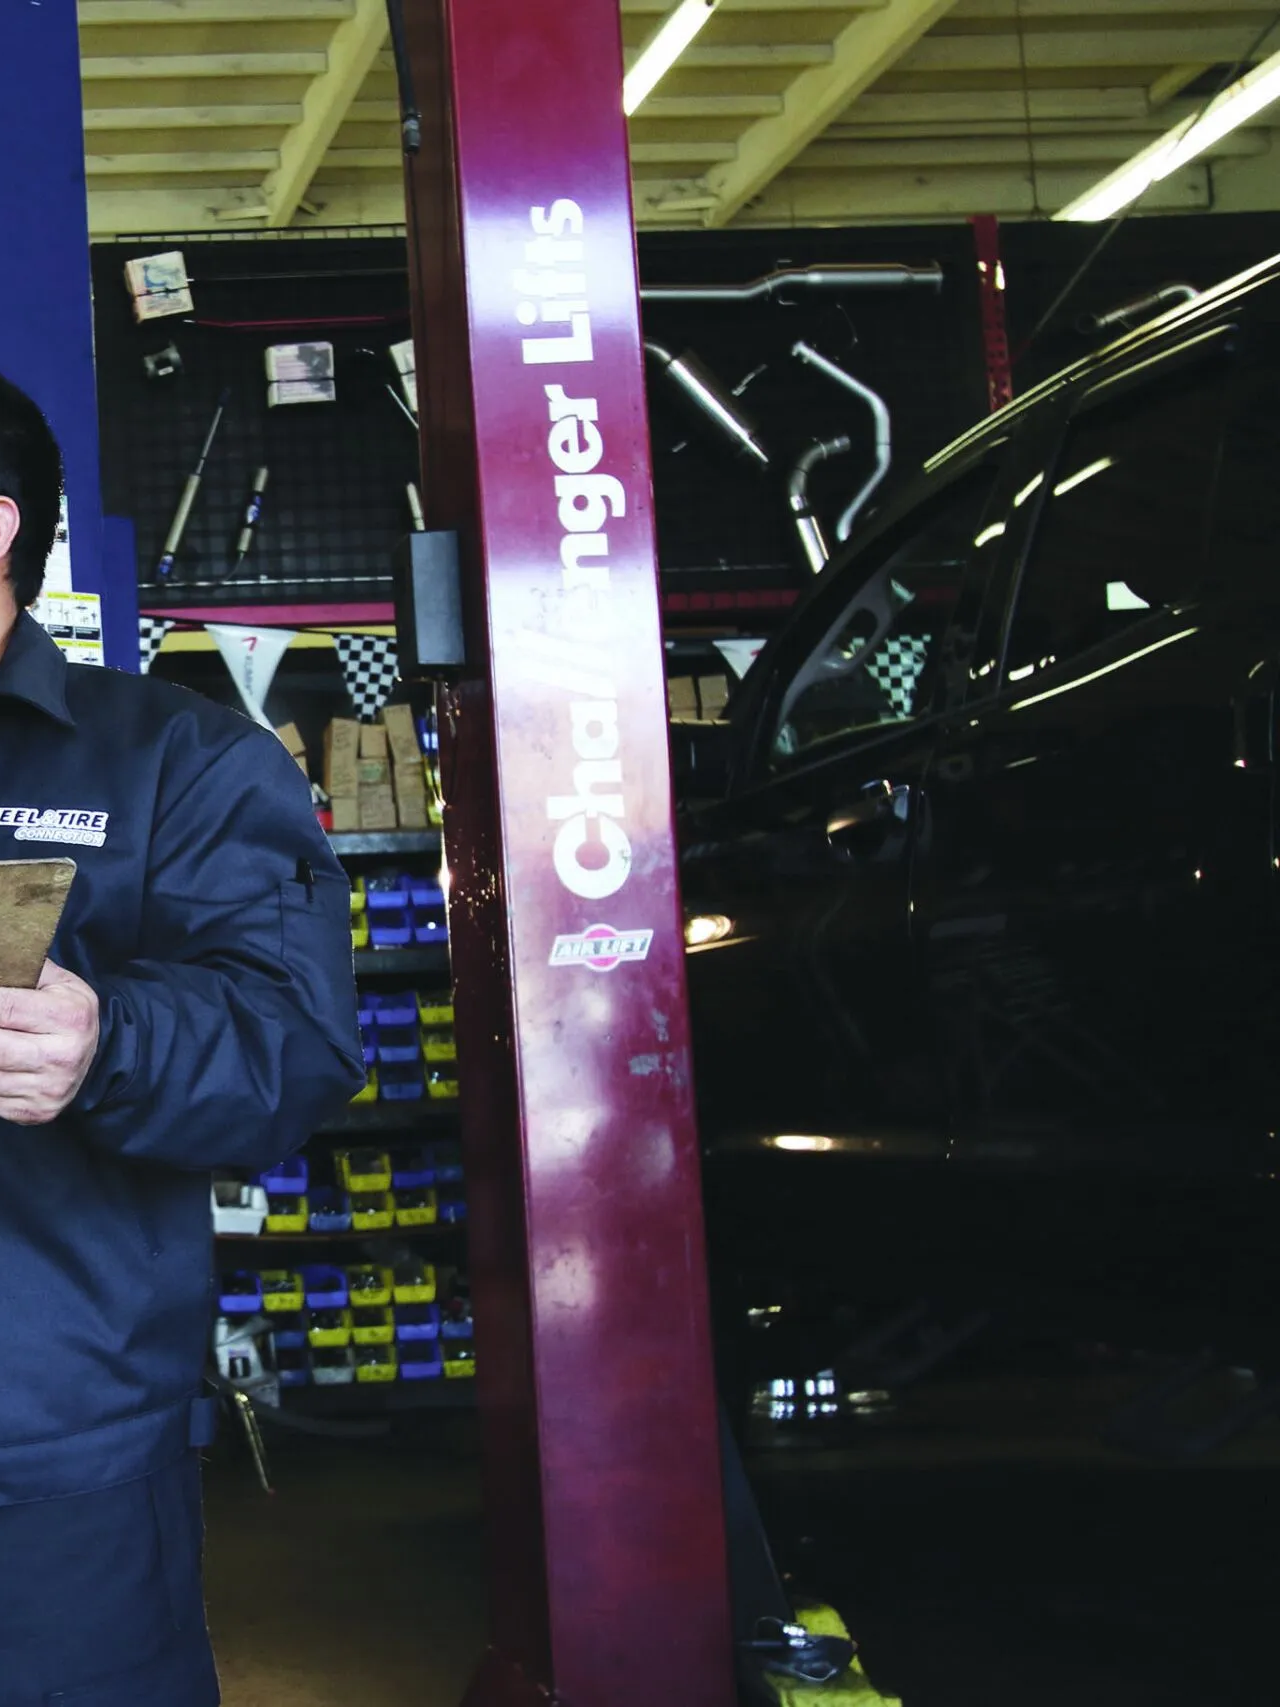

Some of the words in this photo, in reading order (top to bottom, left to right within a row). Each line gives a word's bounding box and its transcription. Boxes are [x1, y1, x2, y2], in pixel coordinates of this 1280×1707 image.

[516, 197, 594, 364] Lifts
[518, 383, 631, 899] Challenger
[58, 812, 105, 828] TIRE
[16, 827, 104, 846] CONNECTION
[555, 939, 599, 957] AIR
[599, 936, 648, 956] LIFT
